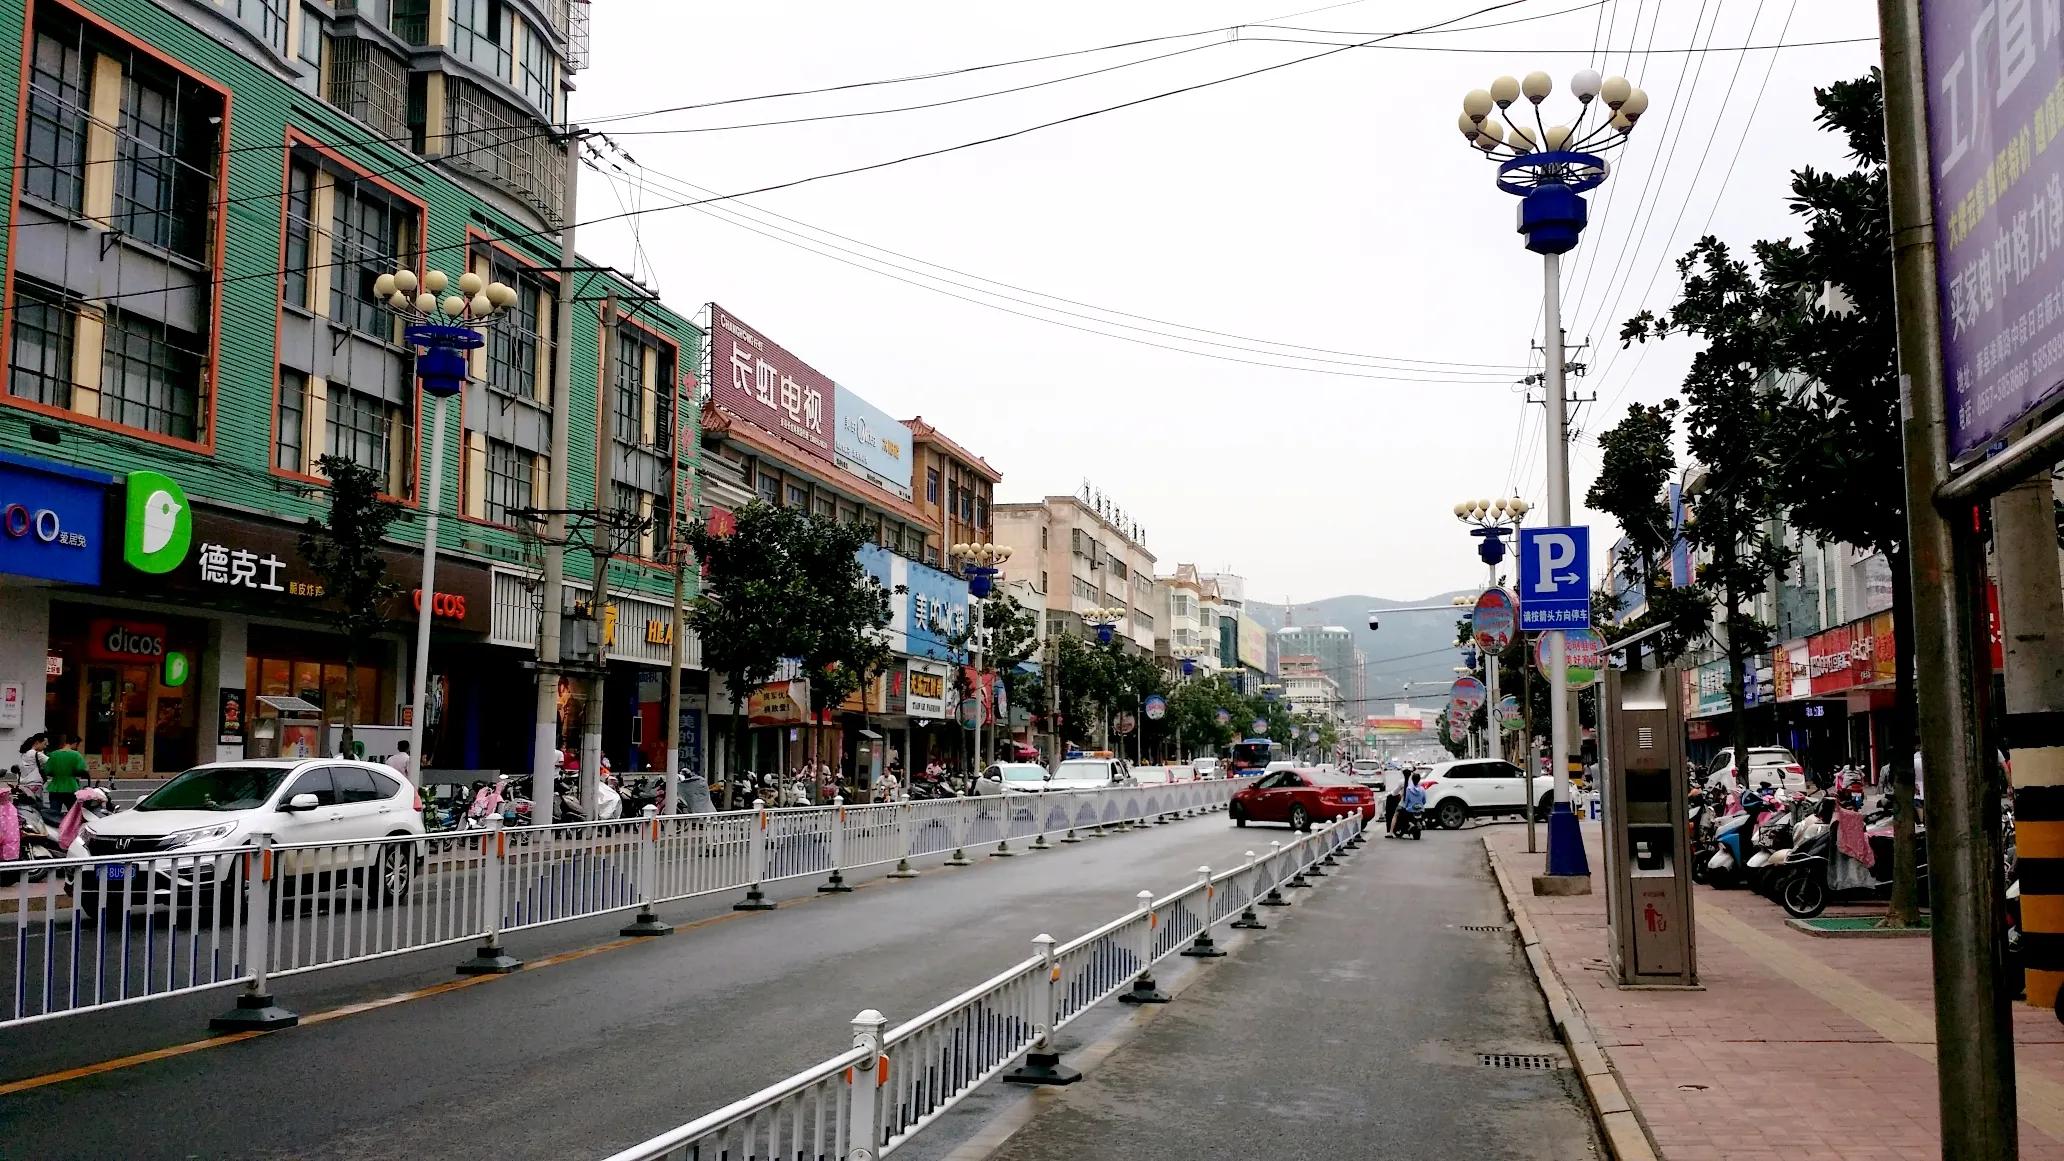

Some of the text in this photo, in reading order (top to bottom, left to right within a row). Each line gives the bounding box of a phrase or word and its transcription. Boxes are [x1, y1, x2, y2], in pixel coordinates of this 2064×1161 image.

[730, 341, 822, 434] 长虹电视
[60, 531, 87, 548] 爱居兔
[199, 543, 287, 592] 德克士
[1533, 533, 1576, 593] P
[1523, 609, 1588, 622] 请按箭头方向停车
[109, 627, 162, 656] dicos
